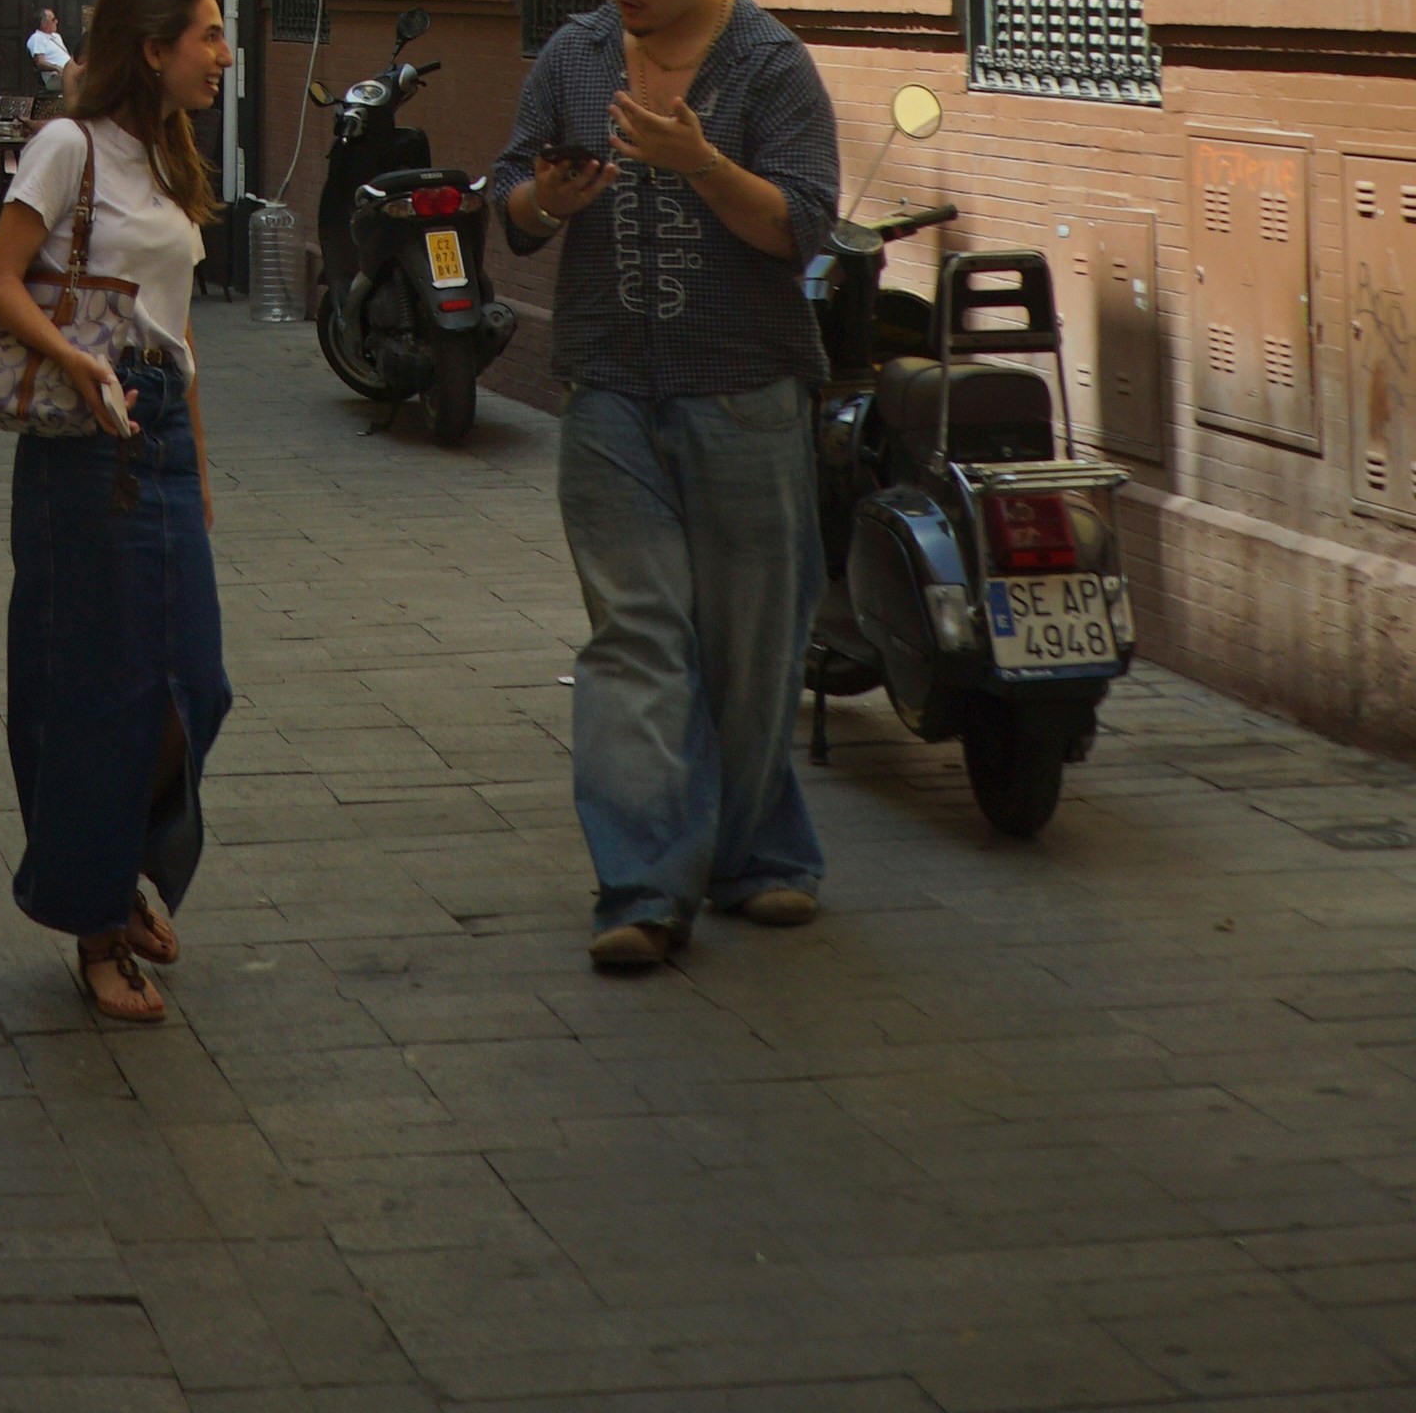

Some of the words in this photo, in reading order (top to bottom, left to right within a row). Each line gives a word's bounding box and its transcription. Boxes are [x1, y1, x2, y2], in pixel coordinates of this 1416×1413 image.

[1009, 581, 1052, 618] SE
[1063, 579, 1098, 615] AP
[1025, 621, 1108, 660] 4948
